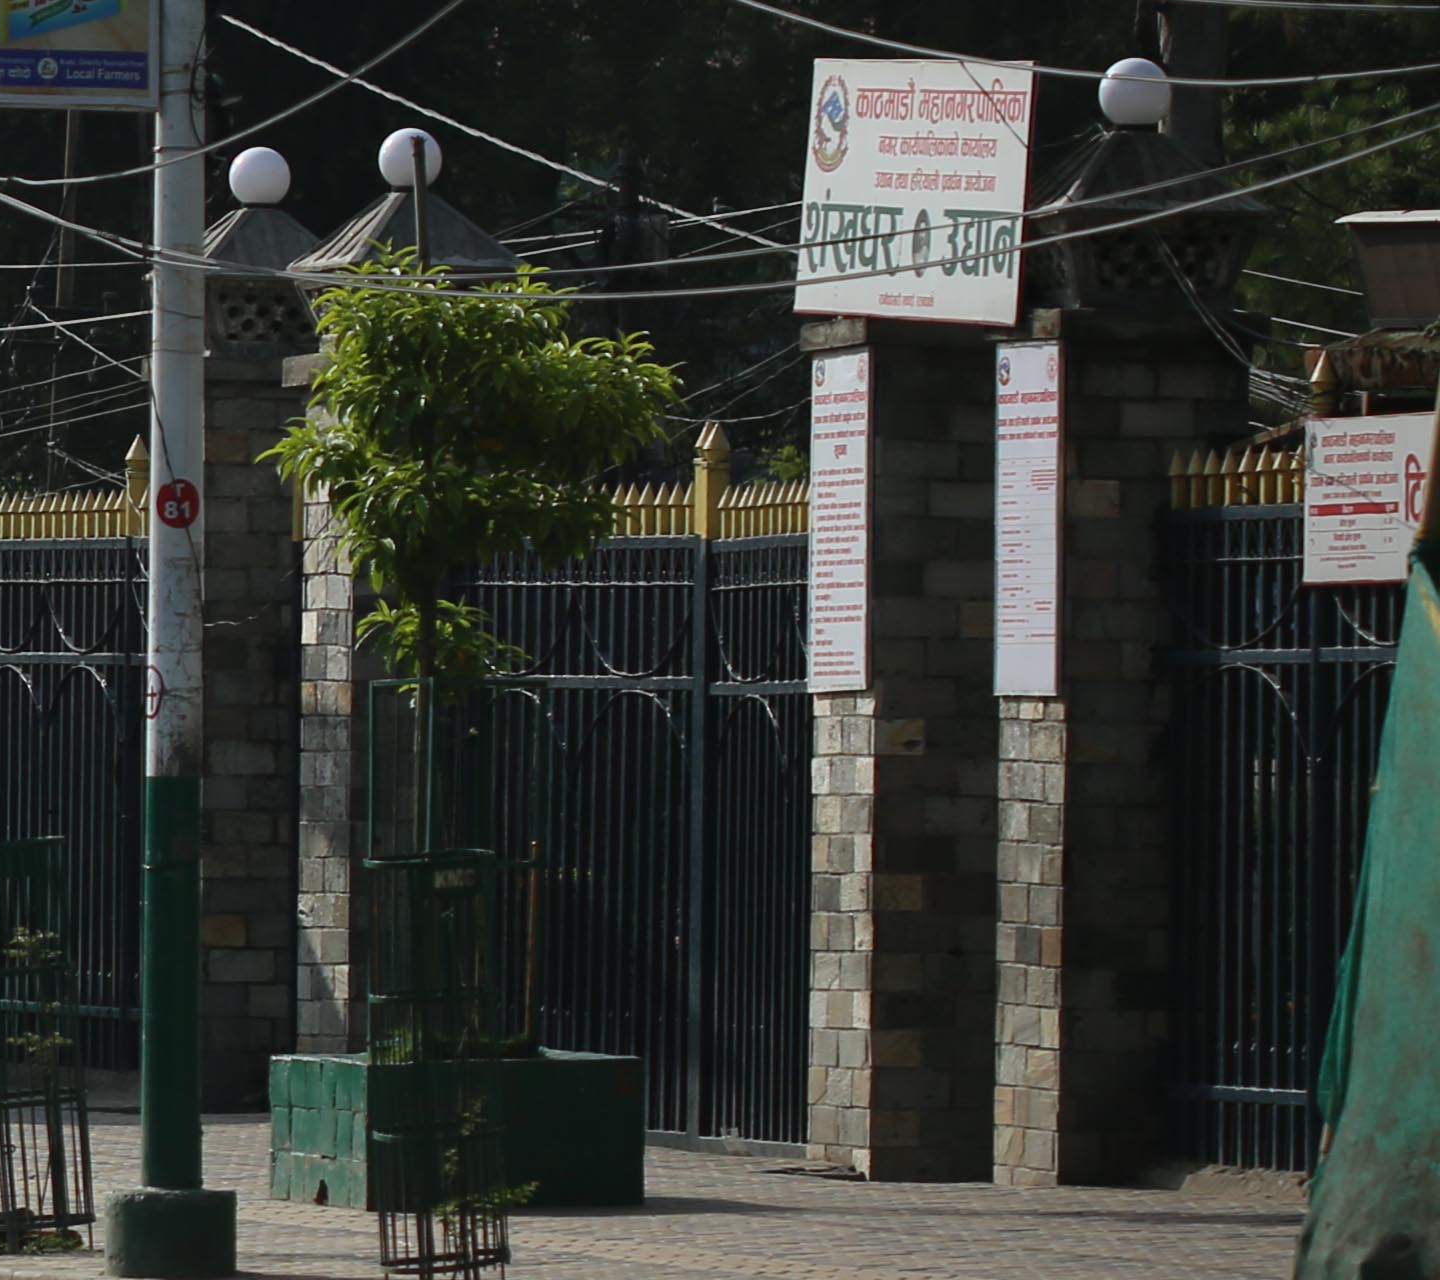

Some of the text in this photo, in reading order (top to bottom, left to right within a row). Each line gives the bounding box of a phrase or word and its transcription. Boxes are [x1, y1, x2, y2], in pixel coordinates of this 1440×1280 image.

[66, 68, 141, 82] Local Farmers
[918, 78, 1028, 125] महानगरपालिका
[170, 483, 185, 497] T
[164, 501, 191, 519] 81
